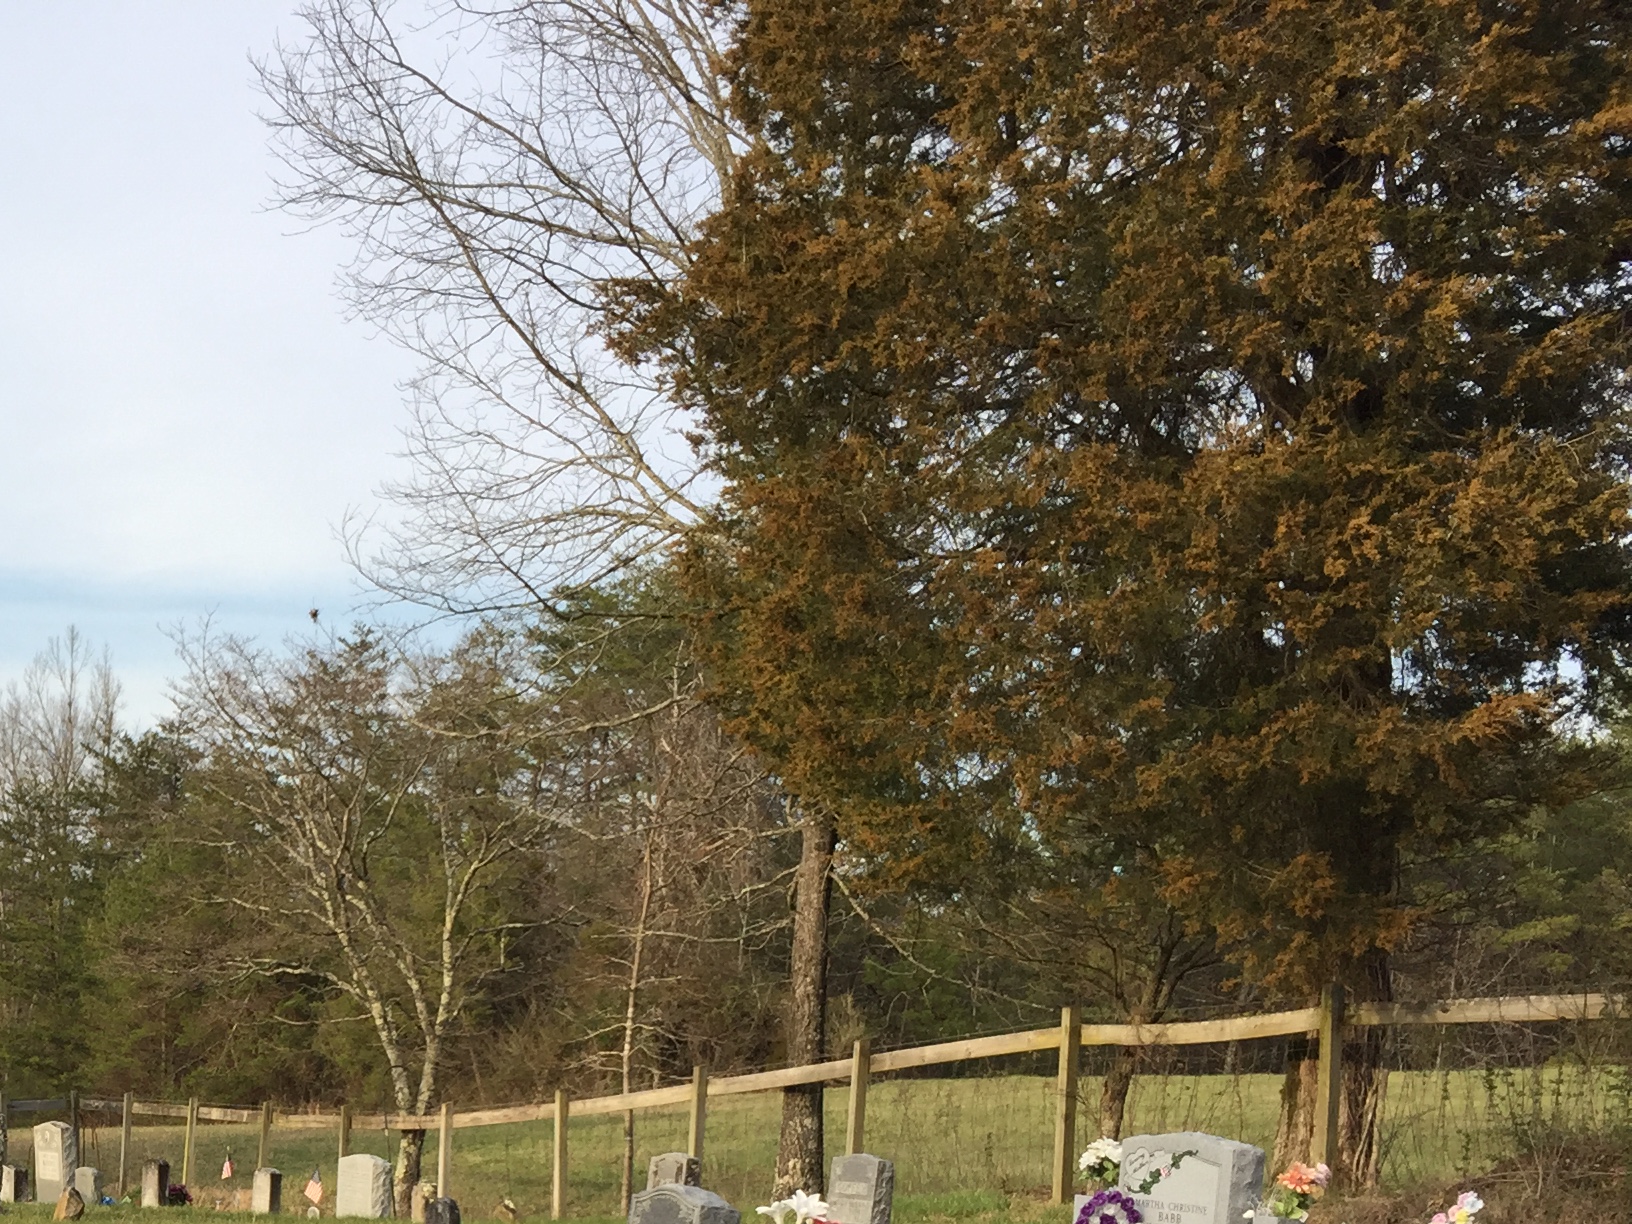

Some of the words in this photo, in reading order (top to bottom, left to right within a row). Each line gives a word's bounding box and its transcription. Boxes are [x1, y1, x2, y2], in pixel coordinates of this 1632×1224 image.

[1135, 1198, 1165, 1210] MARTHA
[1168, 1202, 1208, 1216] CHRISTINE
[1158, 1211, 1182, 1224] BABB
